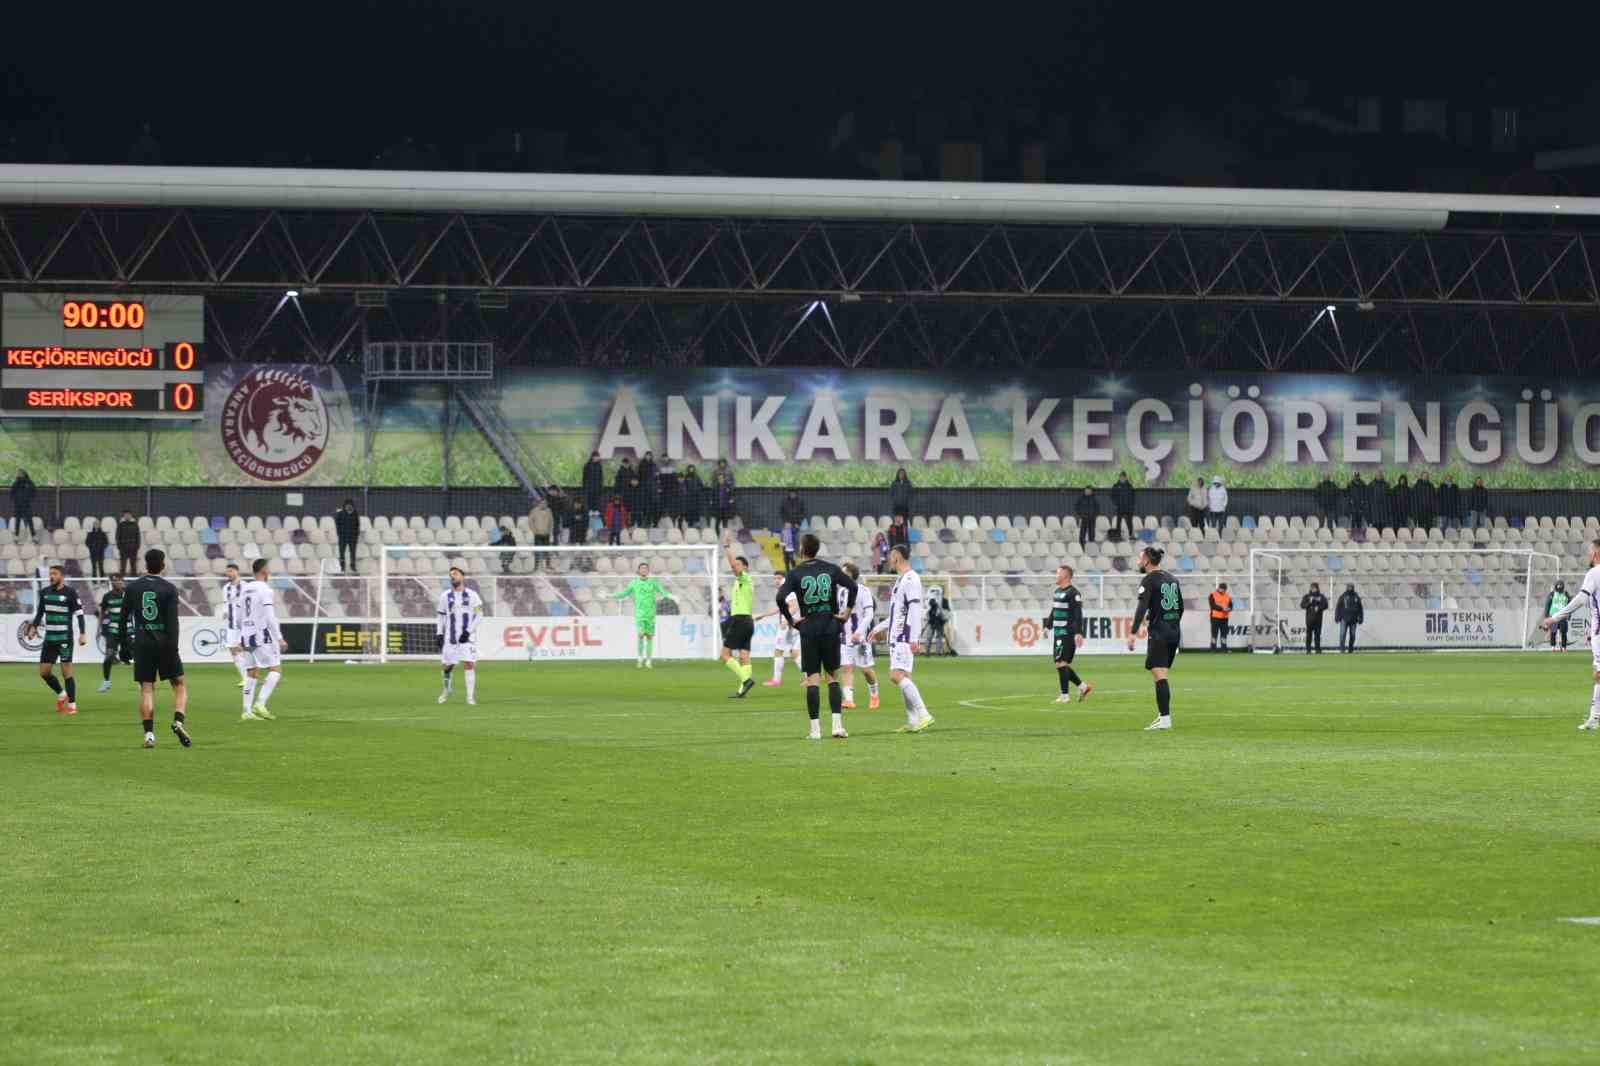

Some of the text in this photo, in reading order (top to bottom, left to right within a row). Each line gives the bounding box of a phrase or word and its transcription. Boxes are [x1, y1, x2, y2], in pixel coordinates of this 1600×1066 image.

[63, 303, 144, 328] 90:00
[7, 342, 194, 370] KEÇİÖRENGÜCÜ 0
[27, 383, 193, 410] SERİKSPOR 0
[599, 395, 979, 461] ANKARA
[801, 573, 831, 604] 28
[142, 591, 158, 621] 5
[503, 619, 603, 647] EVCİL
[1452, 624, 1495, 633] ARAS
